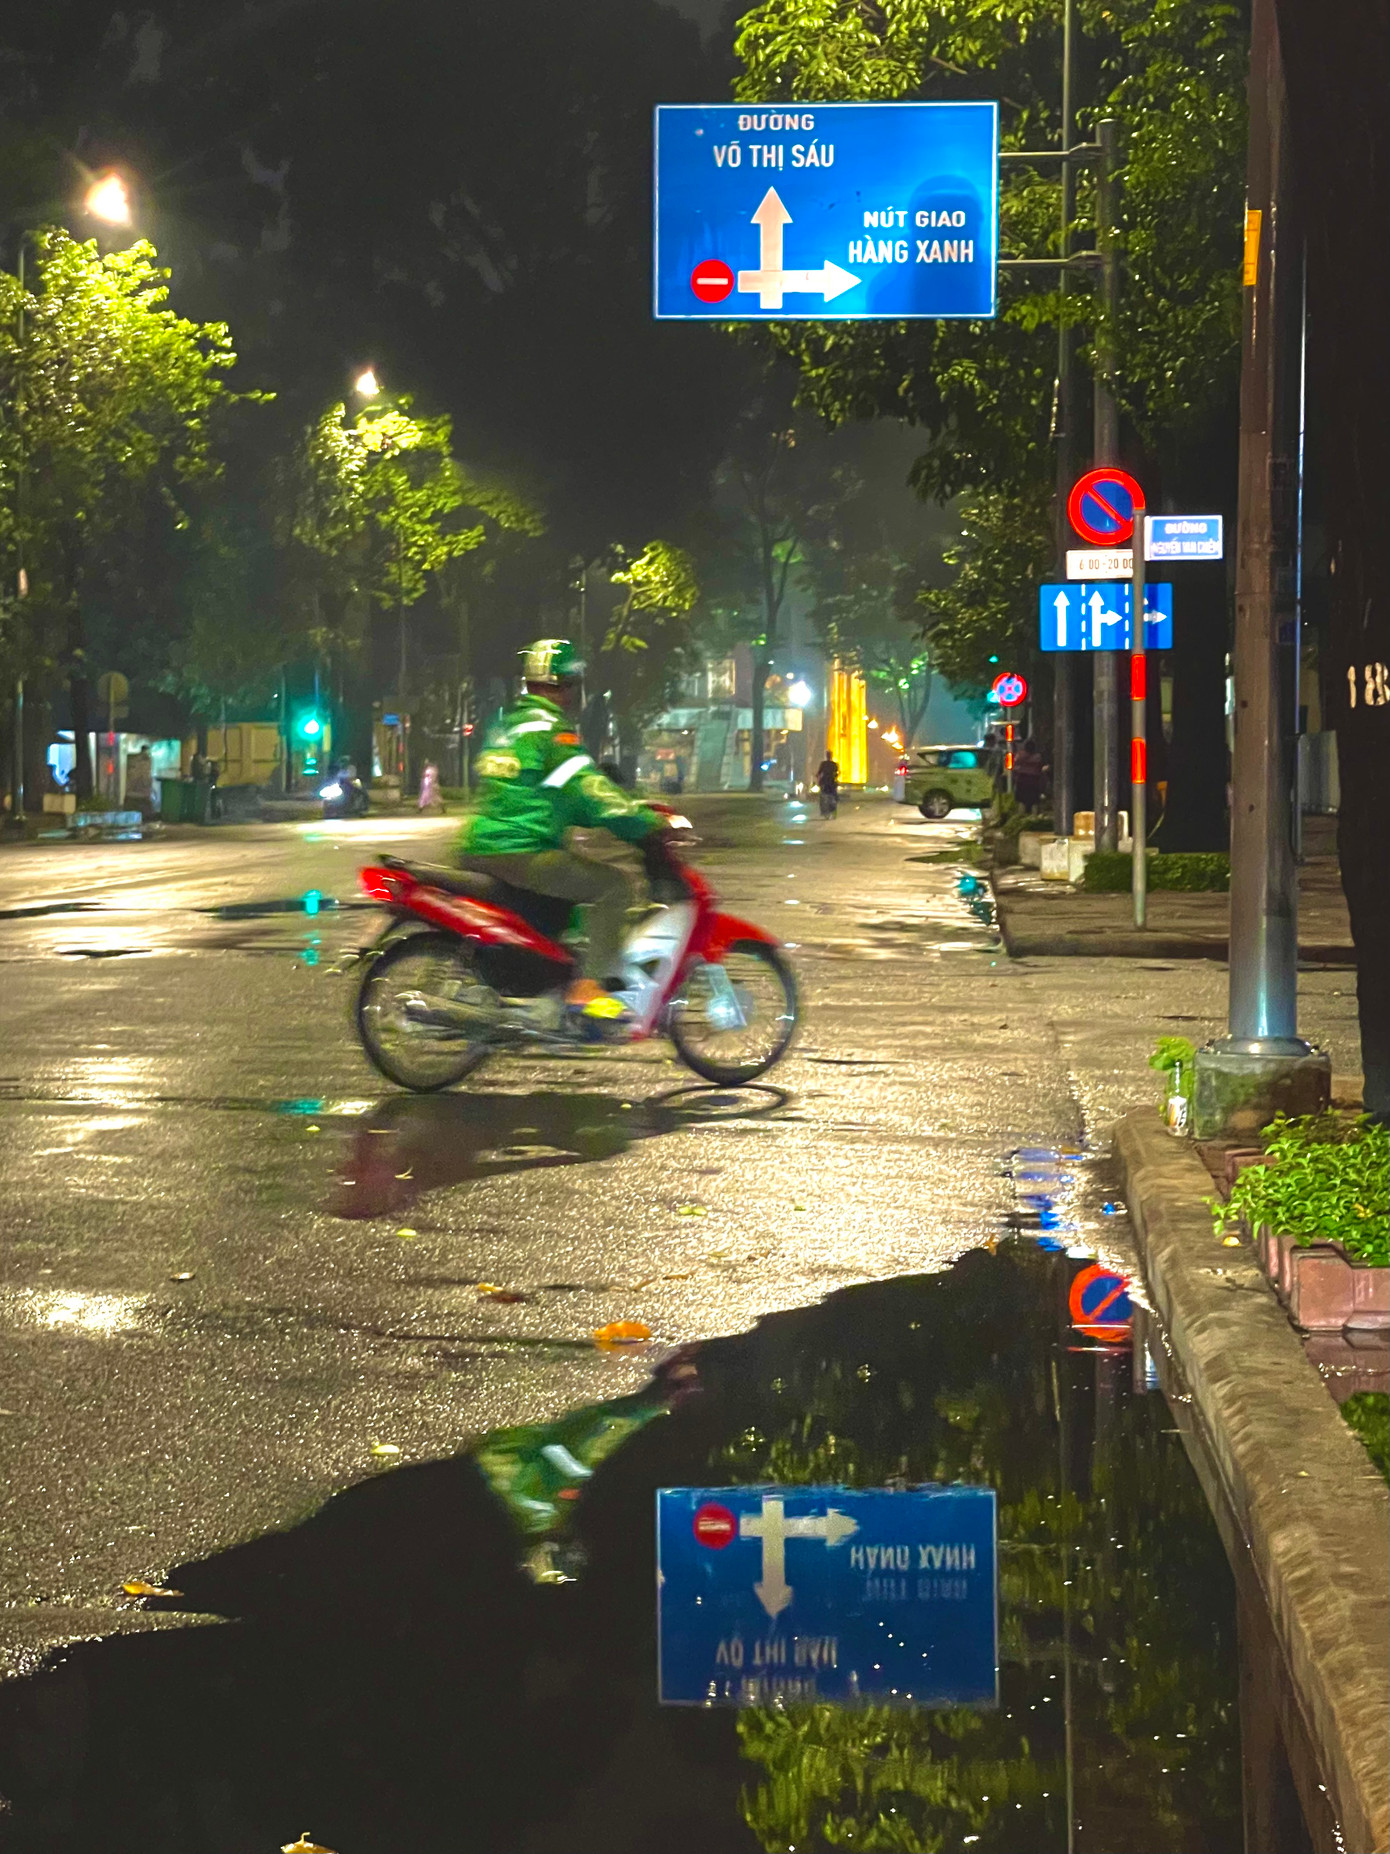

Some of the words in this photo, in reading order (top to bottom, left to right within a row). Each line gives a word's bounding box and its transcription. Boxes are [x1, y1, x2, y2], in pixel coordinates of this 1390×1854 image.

[738, 110, 816, 131] ĐƯỜNG
[713, 140, 742, 168] VÕ
[749, 143, 784, 171] THỊ
[791, 138, 835, 168] SÁU
[863, 206, 909, 228] NÚT
[915, 210, 967, 228] GIAO
[848, 234, 909, 264] HÀNG
[915, 239, 975, 264] XANH
